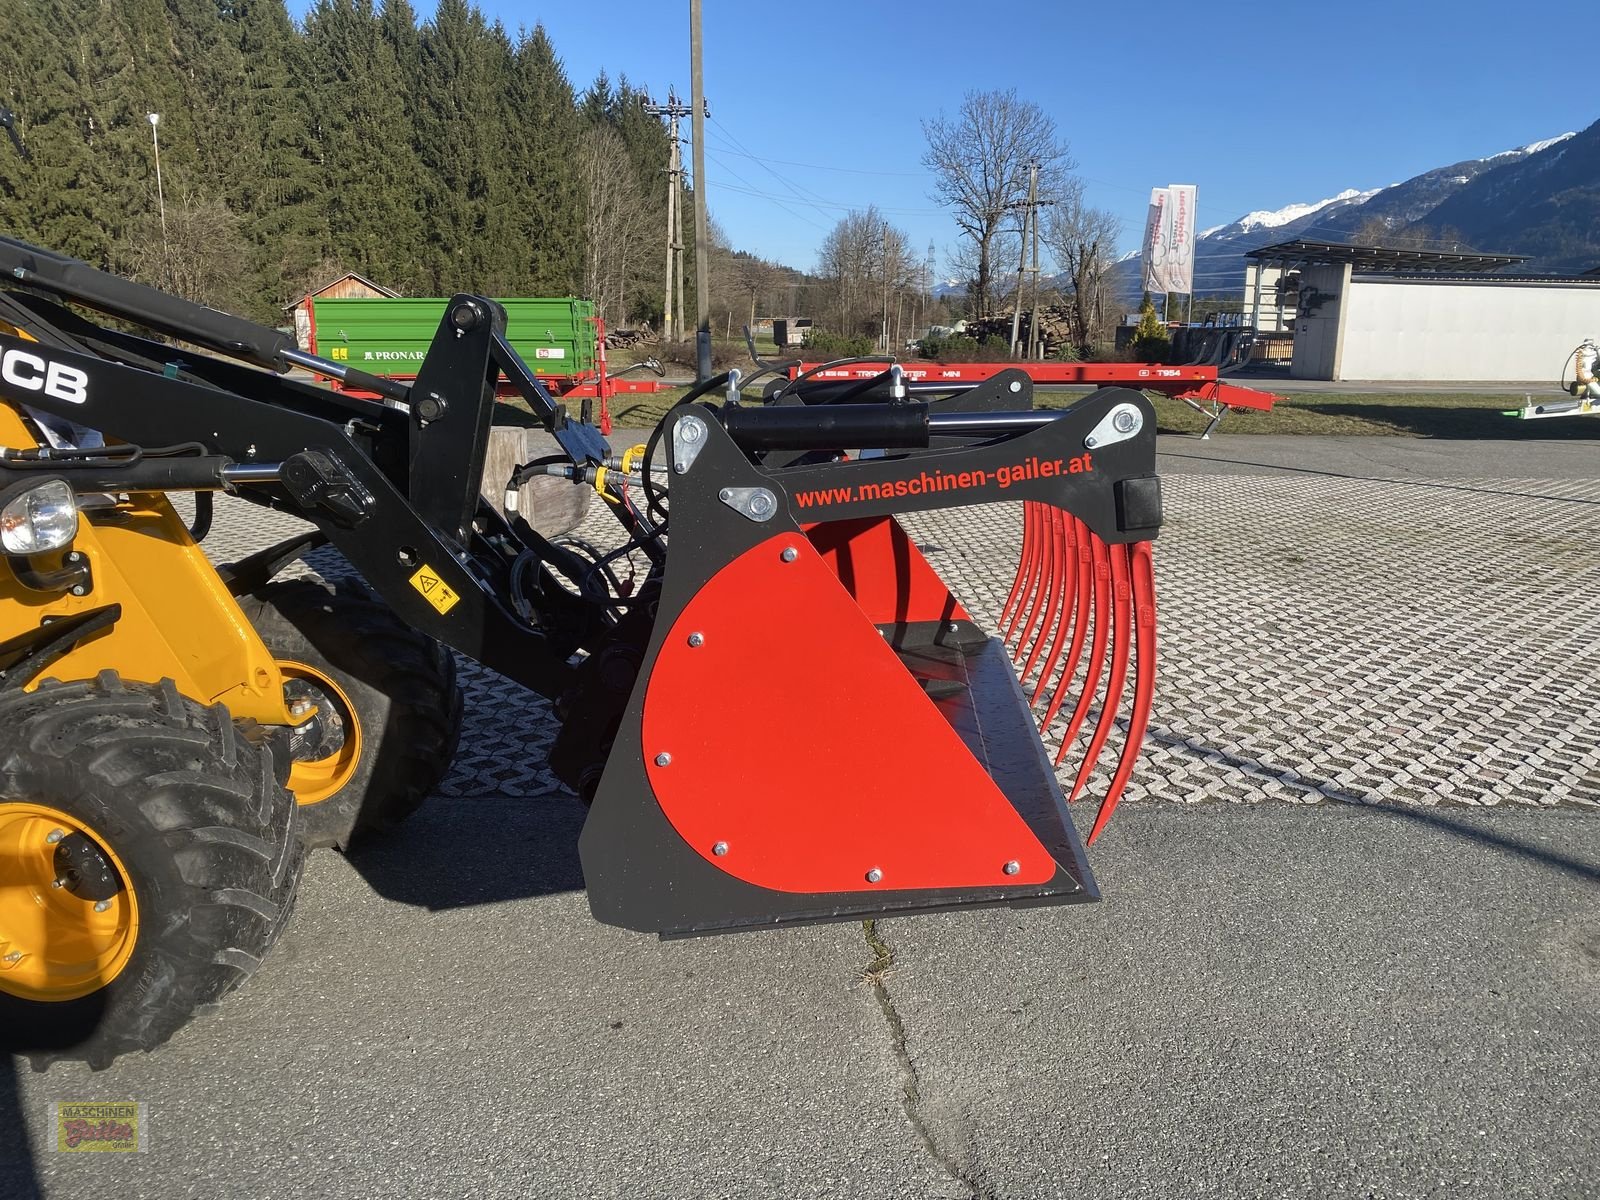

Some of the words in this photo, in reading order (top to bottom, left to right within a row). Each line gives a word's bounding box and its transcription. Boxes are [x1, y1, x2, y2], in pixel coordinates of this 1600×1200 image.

[375, 351, 425, 360] PRONAR
[0, 345, 88, 404] CB
[942, 370, 961, 378] MINI
[1156, 369, 1181, 377] T954
[795, 452, 1093, 508] www.maschinen-gailer.at
